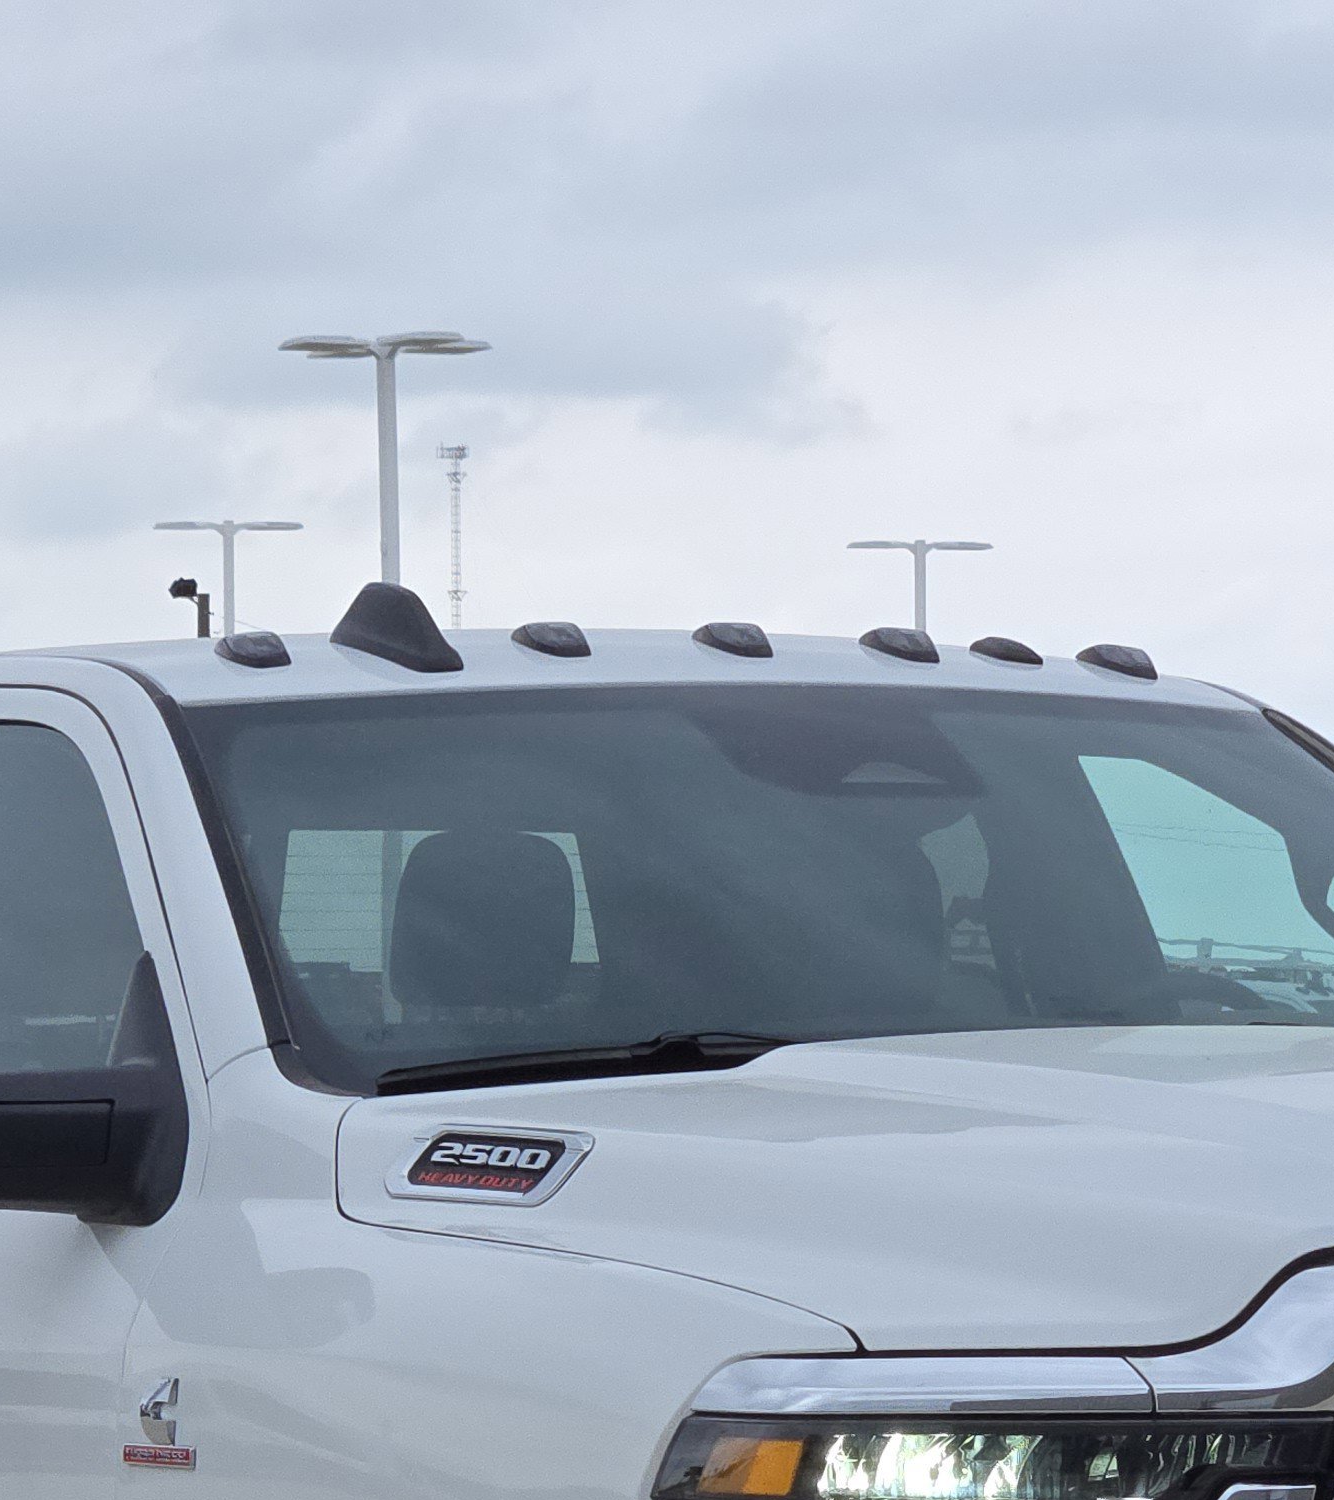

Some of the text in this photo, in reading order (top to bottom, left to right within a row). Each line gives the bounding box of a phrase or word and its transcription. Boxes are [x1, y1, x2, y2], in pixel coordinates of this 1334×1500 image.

[430, 1141, 553, 1170] 2500
[417, 1171, 534, 1190] HEAVY DUTY
